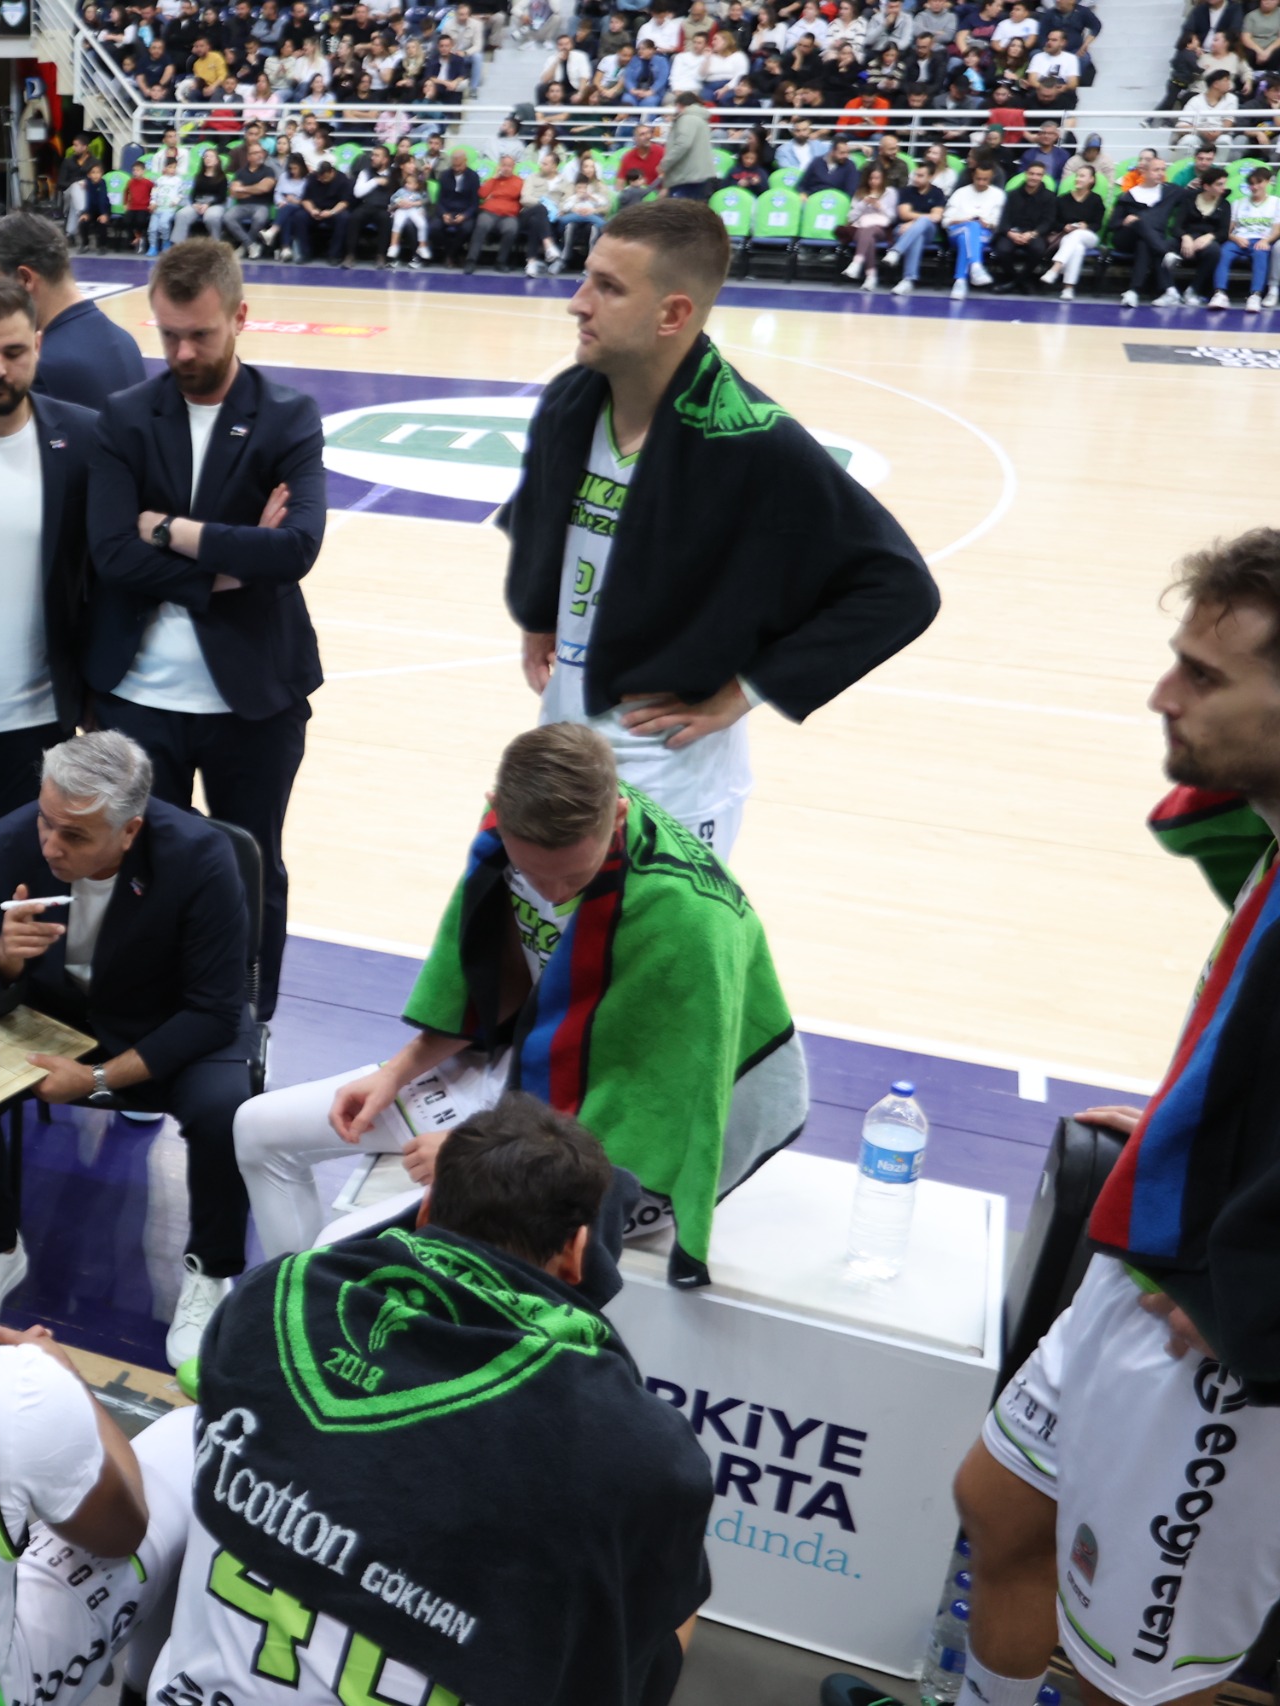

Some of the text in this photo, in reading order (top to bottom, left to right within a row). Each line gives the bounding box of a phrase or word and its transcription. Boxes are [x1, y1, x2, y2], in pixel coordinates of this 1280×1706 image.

[322, 1347, 385, 1393] 2018
[1131, 1422, 1238, 1665] ecogreen
[360, 1560, 477, 1646] GÖKHAN
